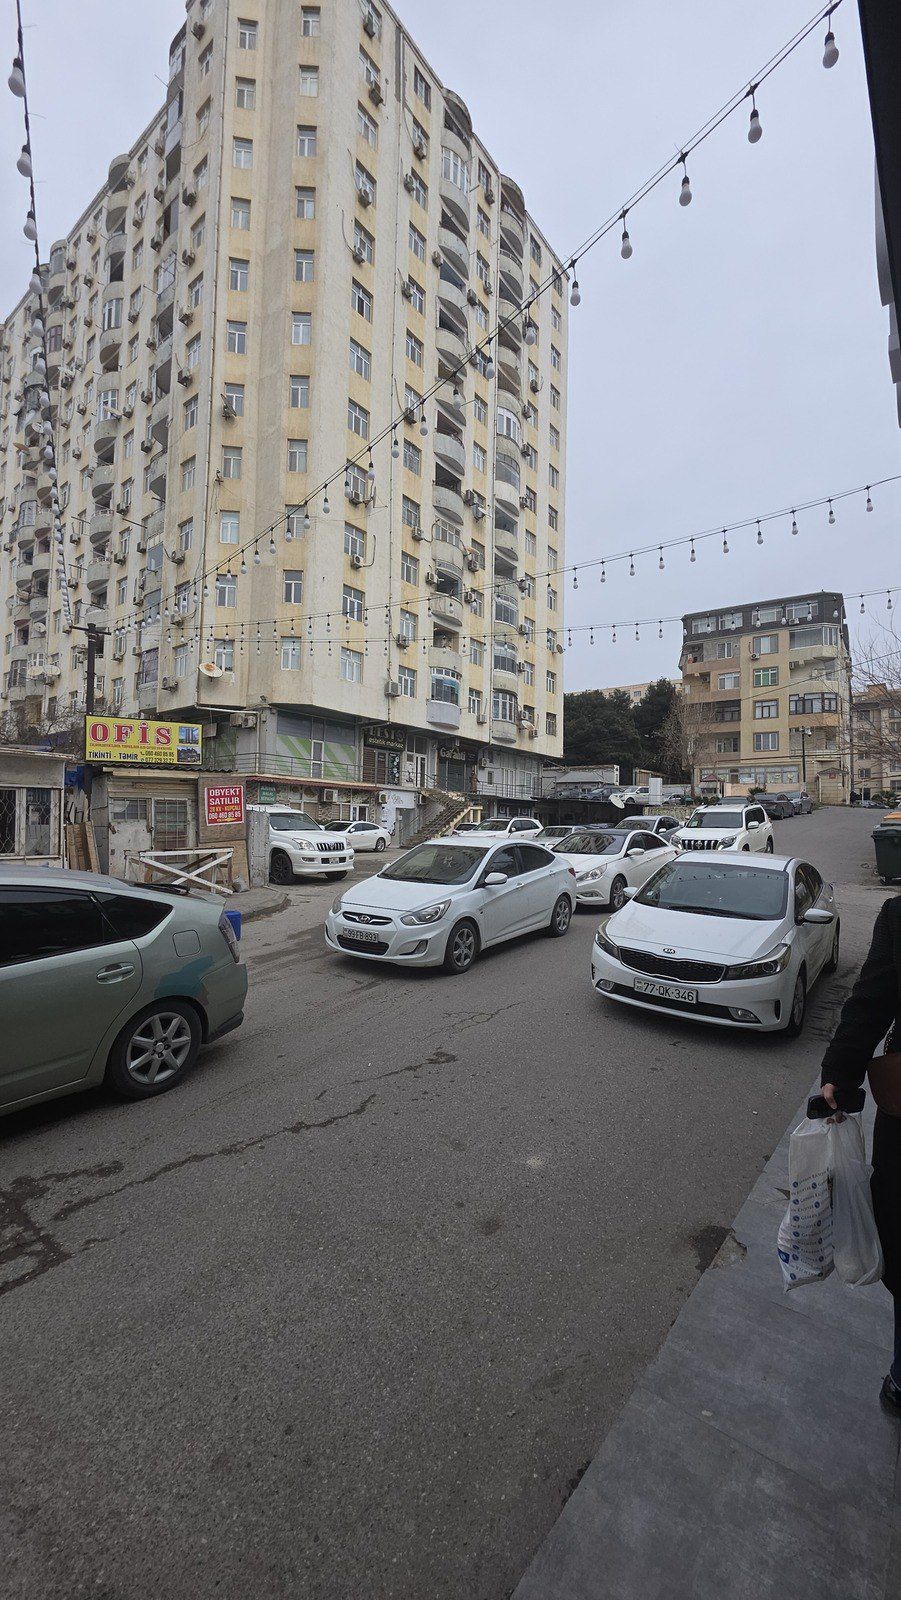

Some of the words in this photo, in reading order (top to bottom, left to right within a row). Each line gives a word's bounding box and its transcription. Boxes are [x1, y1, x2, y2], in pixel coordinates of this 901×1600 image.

[90, 720, 172, 745] OFİS
[88, 750, 112, 760] TİKİNTİ
[119, 751, 138, 761] TƏMİR
[209, 788, 240, 796] OBYEKT
[209, 796, 240, 805] SATILIR
[643, 982, 694, 1002] 77-QK-346
